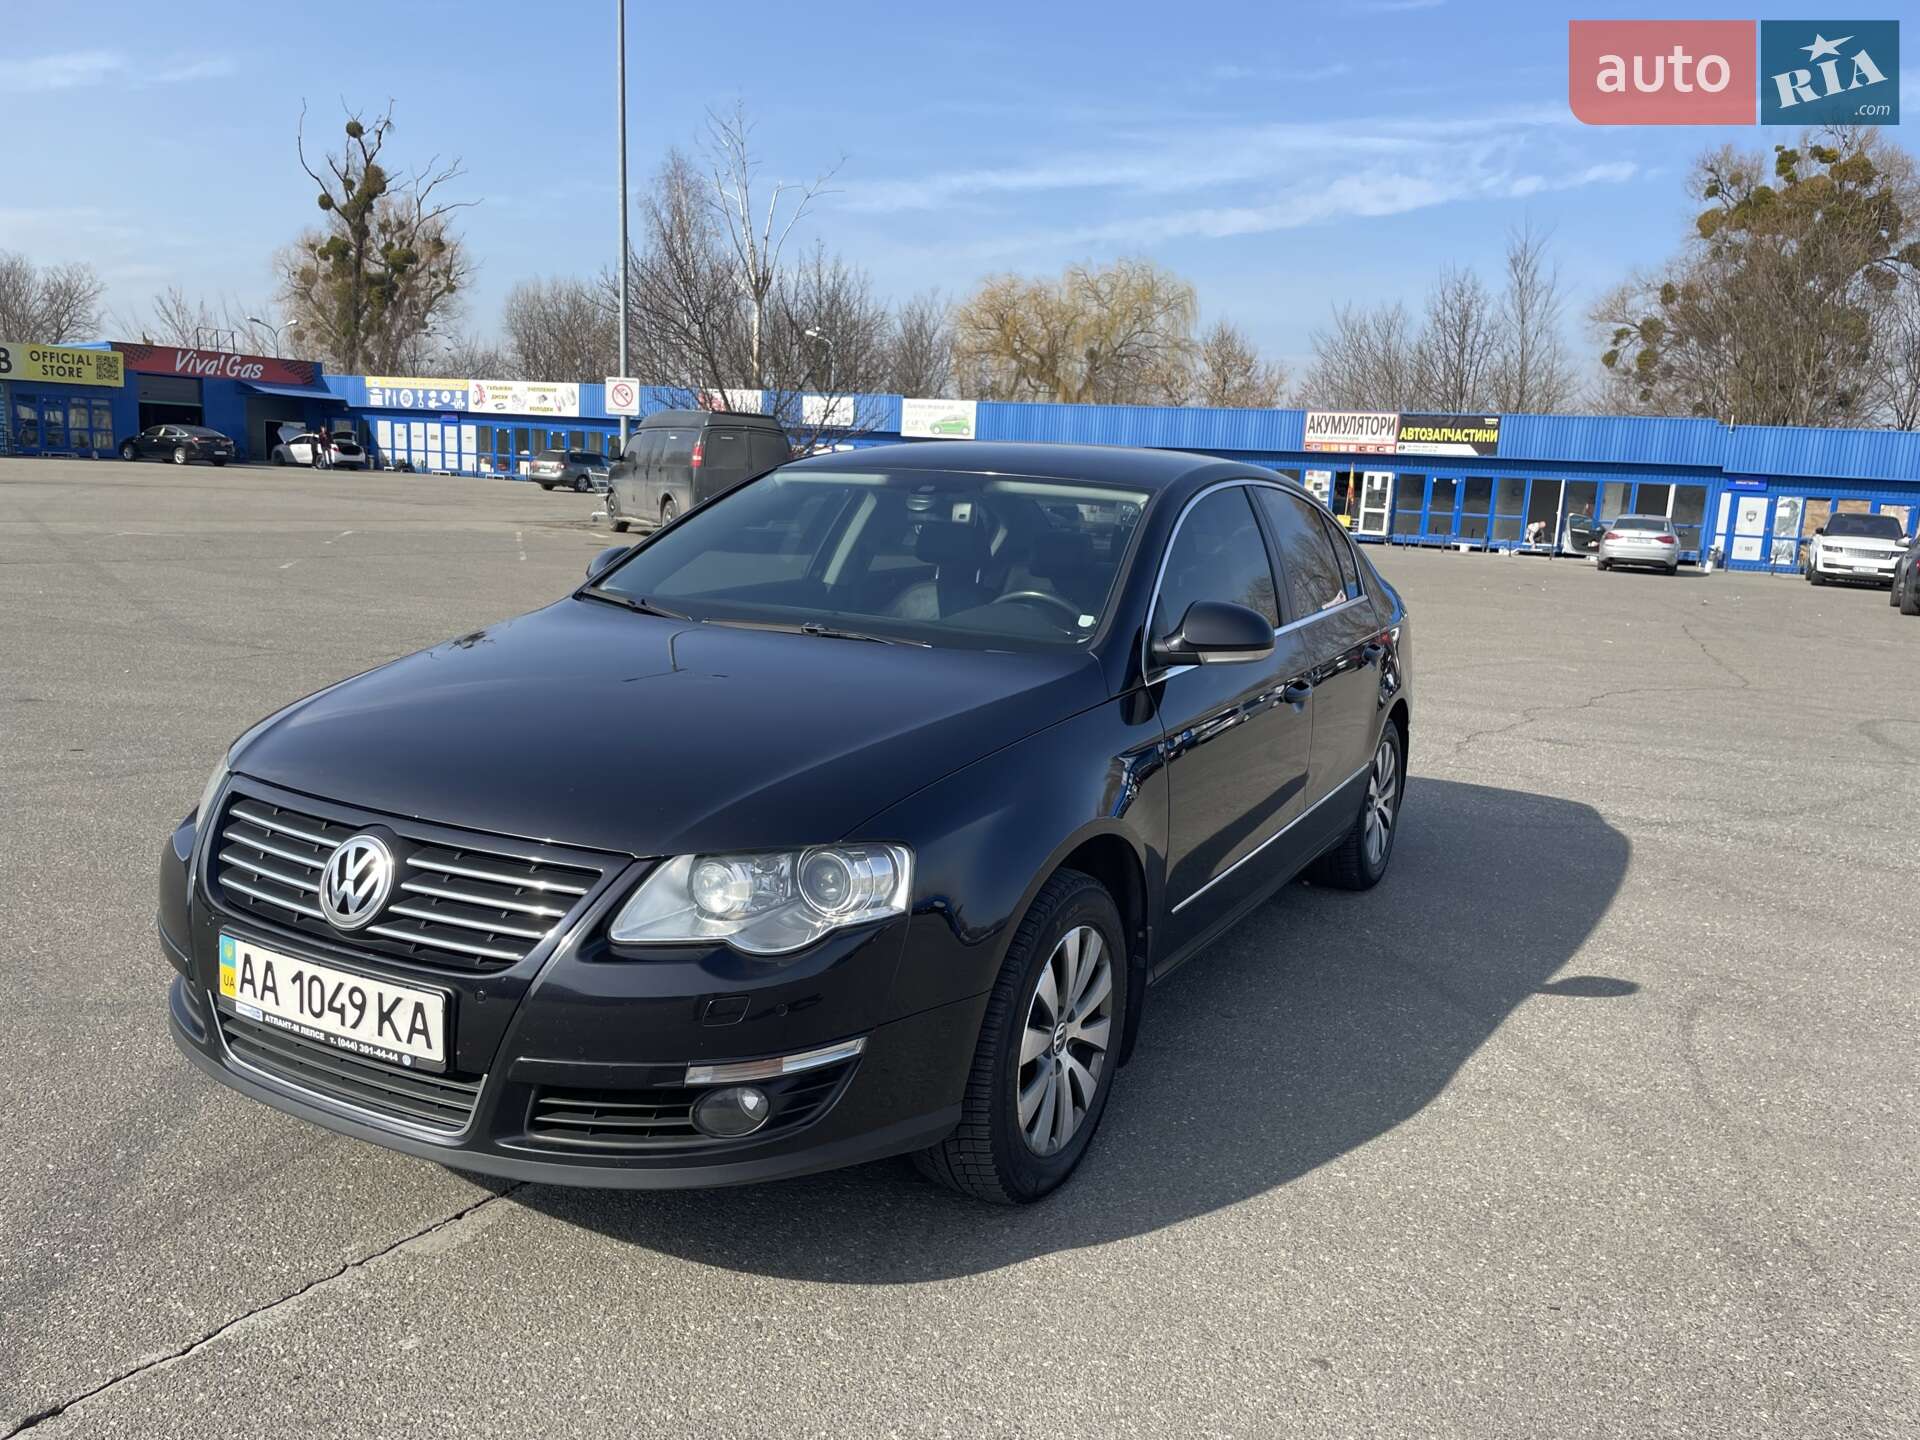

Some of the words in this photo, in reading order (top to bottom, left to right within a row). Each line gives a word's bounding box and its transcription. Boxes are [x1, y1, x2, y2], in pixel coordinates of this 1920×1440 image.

[29, 350, 92, 366] OFFICIAL
[175, 349, 225, 375] Viva!
[226, 355, 264, 379] Gas
[42, 365, 83, 378] STORE
[1307, 415, 1396, 437] АКУМУЛЯТОРИ
[1399, 426, 1498, 443] АВТОЗАПЧАСТИНИ
[224, 975, 235, 990] UA
[239, 953, 280, 1006] AA
[290, 970, 367, 1029] 1049
[377, 991, 433, 1050] KA
